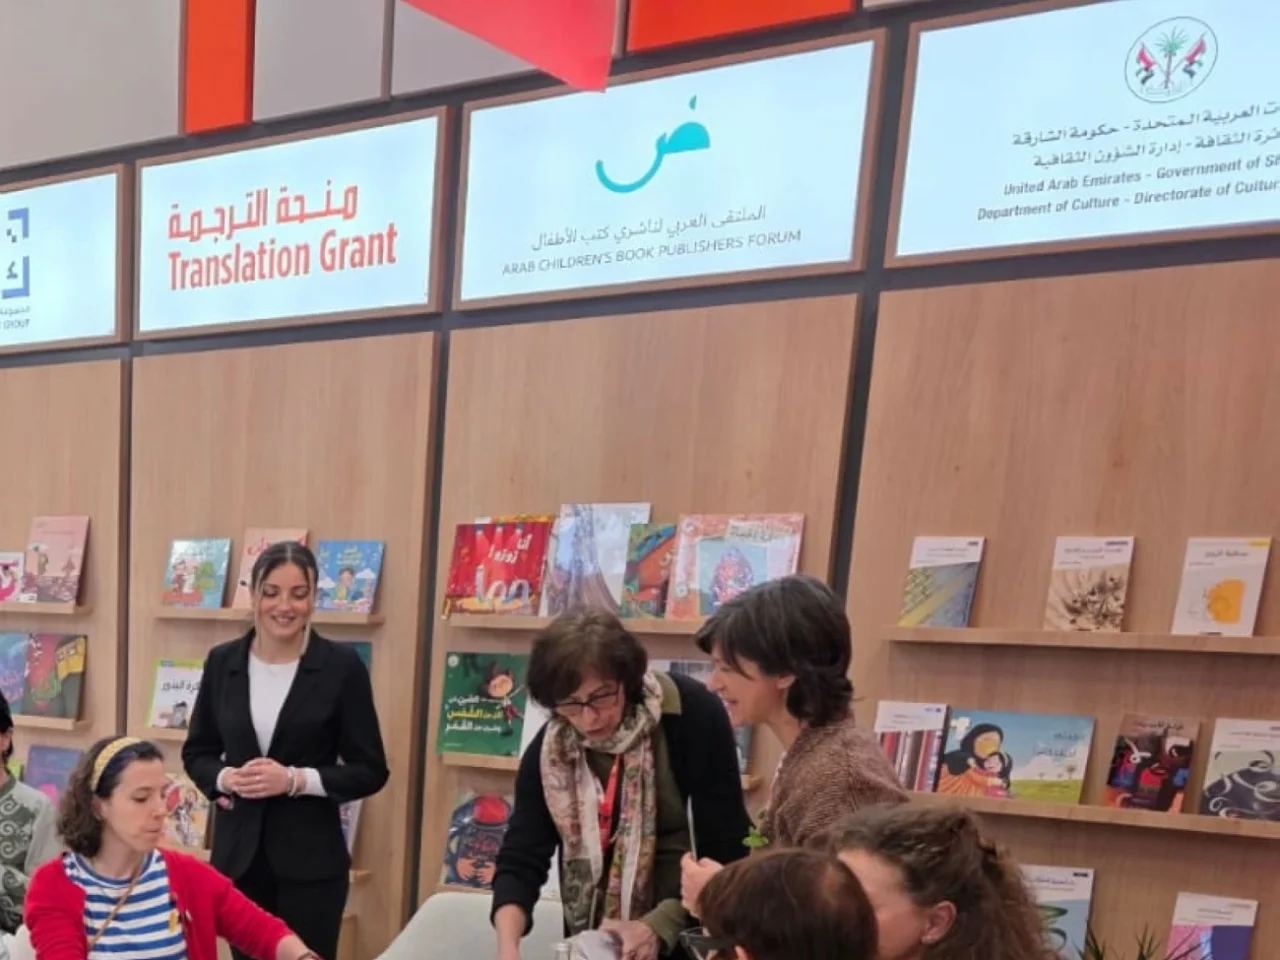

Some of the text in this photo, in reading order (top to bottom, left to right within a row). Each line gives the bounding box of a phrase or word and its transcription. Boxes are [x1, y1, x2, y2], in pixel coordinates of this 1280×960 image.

[1132, 112, 1200, 131] المتحدة
[1202, 104, 1260, 126] العربية
[1012, 129, 1066, 147] الشارقة
[1069, 122, 1119, 141] حكومة
[1194, 131, 1251, 149] الثقافة
[1032, 150, 1091, 170] الثقافية
[1003, 180, 1045, 196] United
[1047, 176, 1078, 191] Arab
[1082, 169, 1142, 188] Emirates
[1156, 157, 1242, 179] Government
[1245, 155, 1261, 171] of
[167, 179, 359, 244] منحة الترجمة
[977, 200, 1052, 222] Department
[1055, 199, 1069, 213] of
[1071, 195, 1120, 211] Culture
[1134, 184, 1212, 205] Directorate
[1215, 181, 1231, 196] of
[666, 212, 708, 239] العربي
[710, 204, 767, 229] الملتقى
[580, 225, 611, 246] كتب
[167, 222, 398, 291] Translation Grant
[502, 229, 802, 276] ARAB CHILDREN'S BOOK PUBLISHERS FORUM
